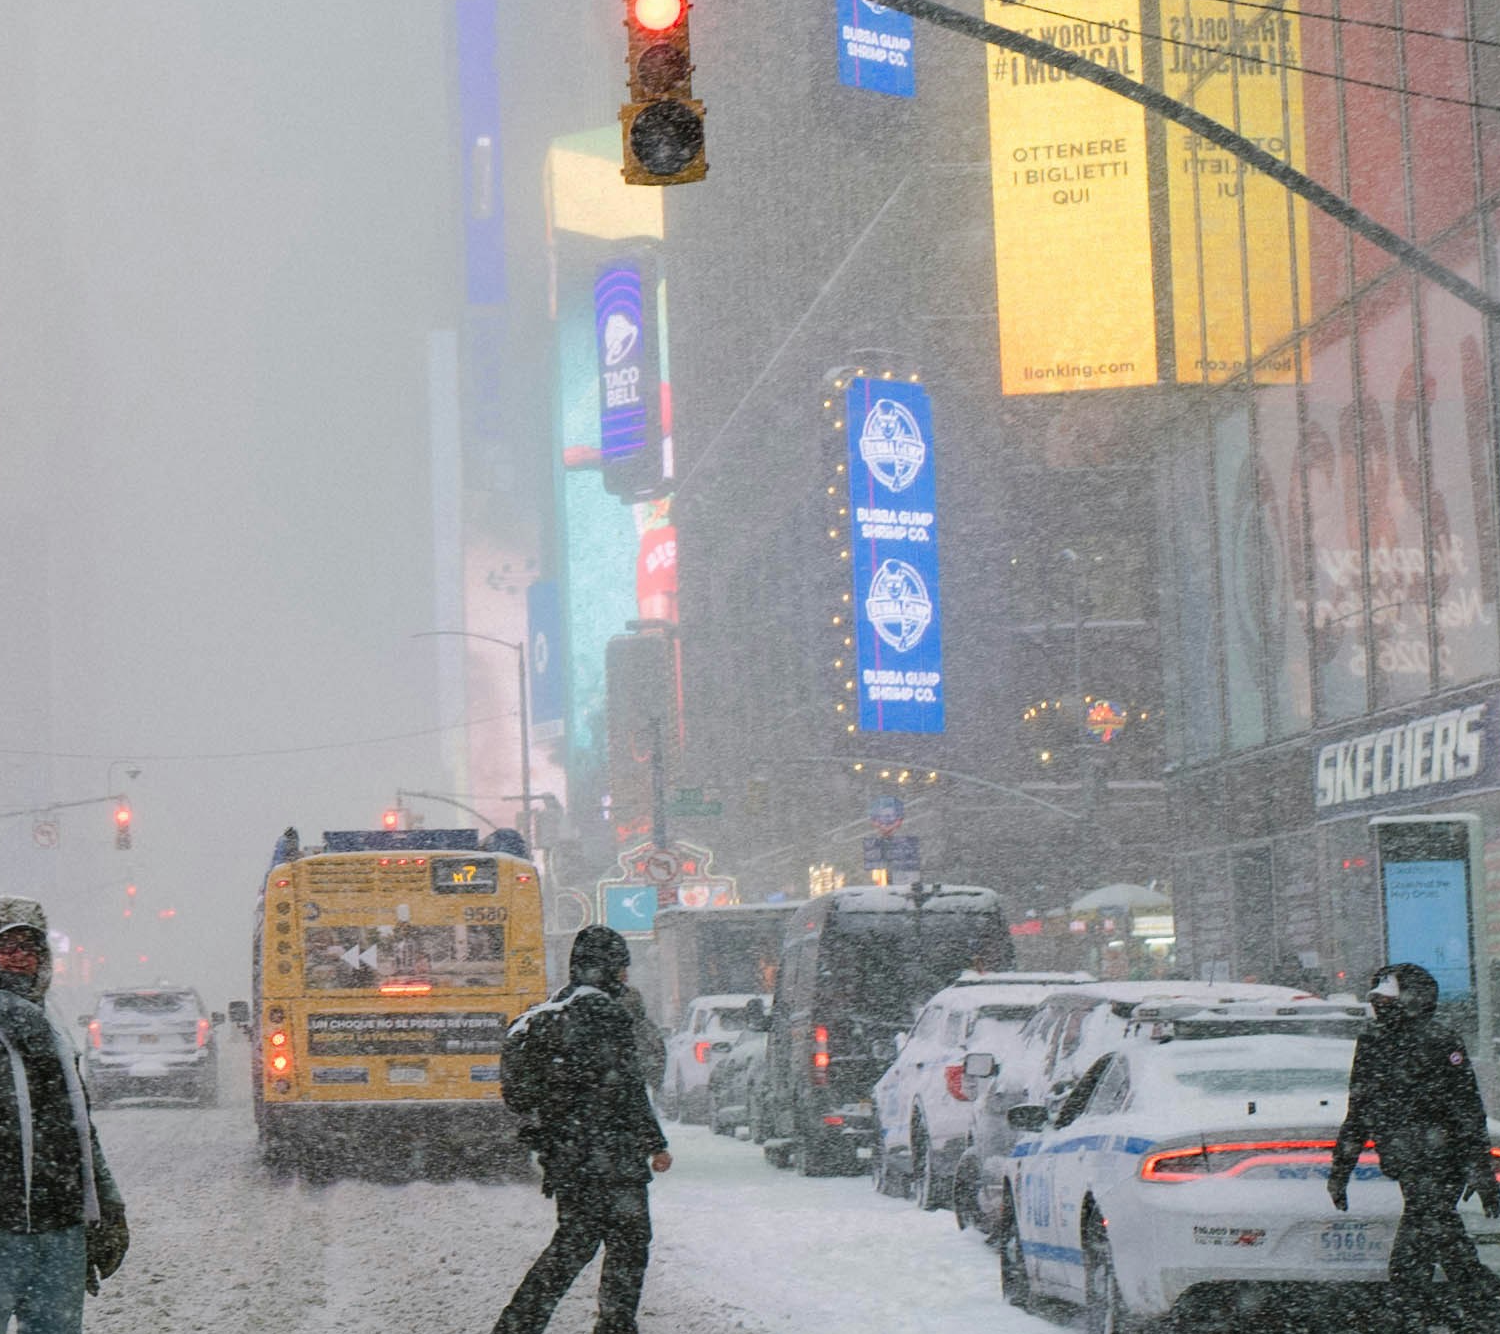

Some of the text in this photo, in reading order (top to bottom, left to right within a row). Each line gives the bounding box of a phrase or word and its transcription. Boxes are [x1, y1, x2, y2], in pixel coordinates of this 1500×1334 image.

[842, 25, 911, 53] BUBBA GUMP
[1038, 18, 1130, 49] WORLD'S
[847, 42, 908, 68] SHRIMP CO.
[1013, 138, 1127, 163] OTTENERE
[1026, 161, 1129, 185] BIGLIETTI
[1052, 187, 1091, 205] QUI
[604, 367, 640, 390] TACO
[1024, 360, 1135, 381] lionking.com
[607, 385, 640, 409] BELL
[857, 508, 933, 526] BUBBA GUMP
[861, 524, 930, 542] SHRIMP CO.
[863, 670, 940, 687] BUBBA GUMP
[868, 685, 936, 702] SHRIMP CO.
[1316, 701, 1488, 808] SKECHERS
[311, 1019, 328, 1031] UN
[329, 1019, 376, 1031] CHOQUE
[377, 1019, 392, 1030] NO
[394, 1019, 408, 1030] SE
[410, 1018, 446, 1029] PUEDE
